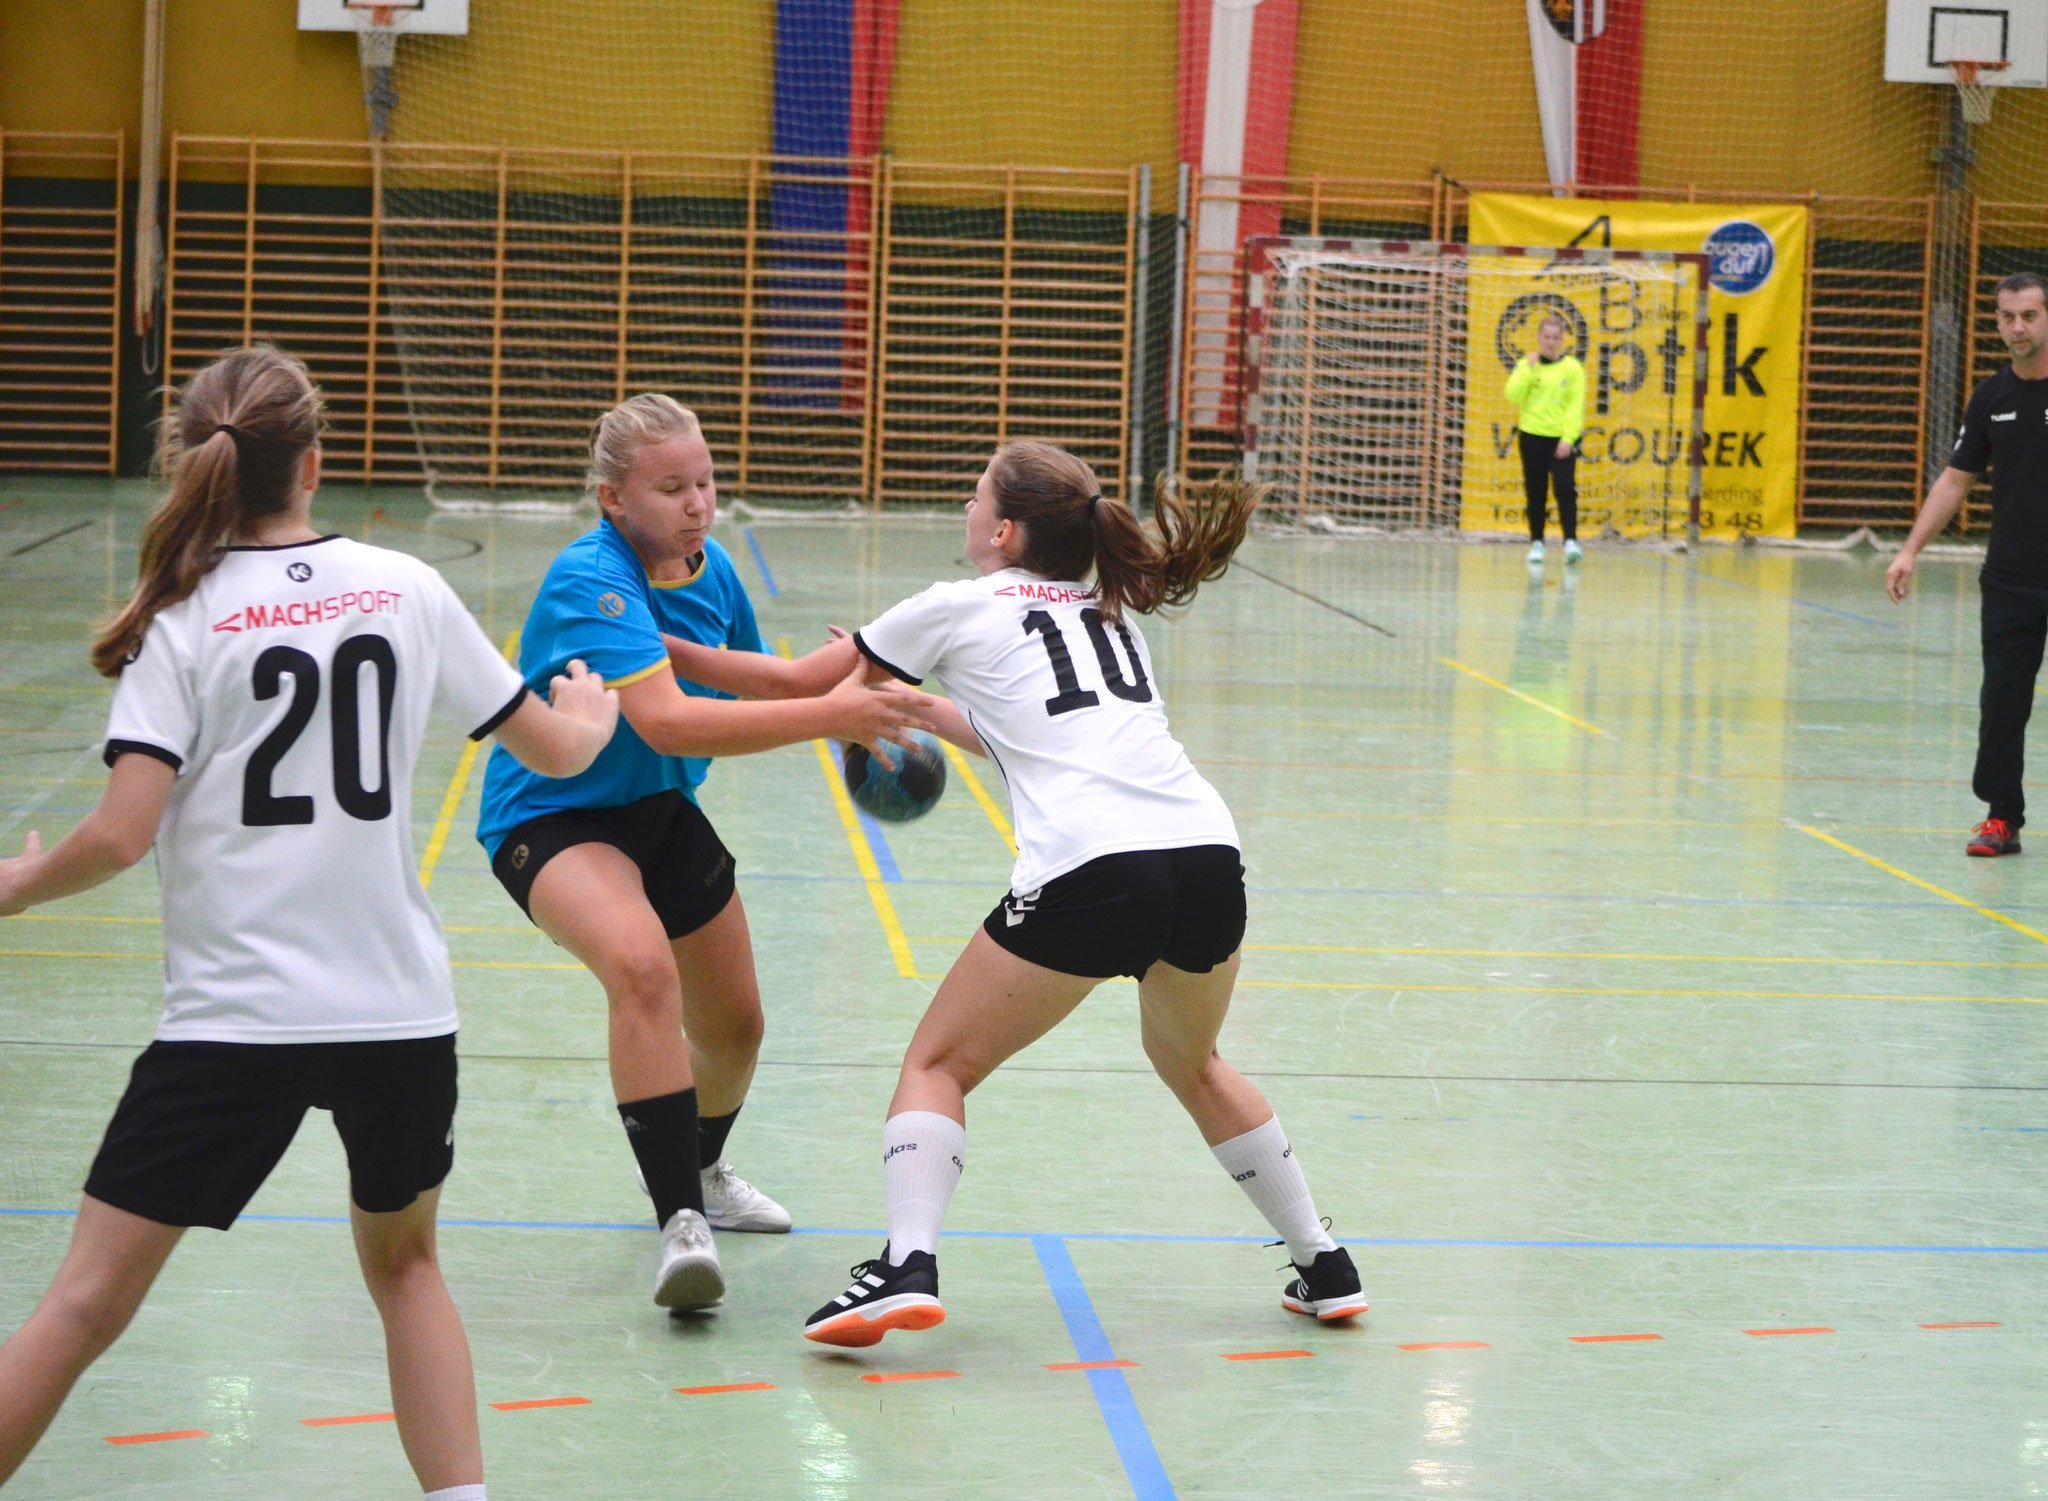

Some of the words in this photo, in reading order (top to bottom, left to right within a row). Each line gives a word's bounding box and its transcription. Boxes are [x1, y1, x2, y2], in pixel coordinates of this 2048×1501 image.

[246, 591, 402, 628] MACHSPORT
[1021, 607, 1153, 717] 10
[242, 633, 397, 827] 20
